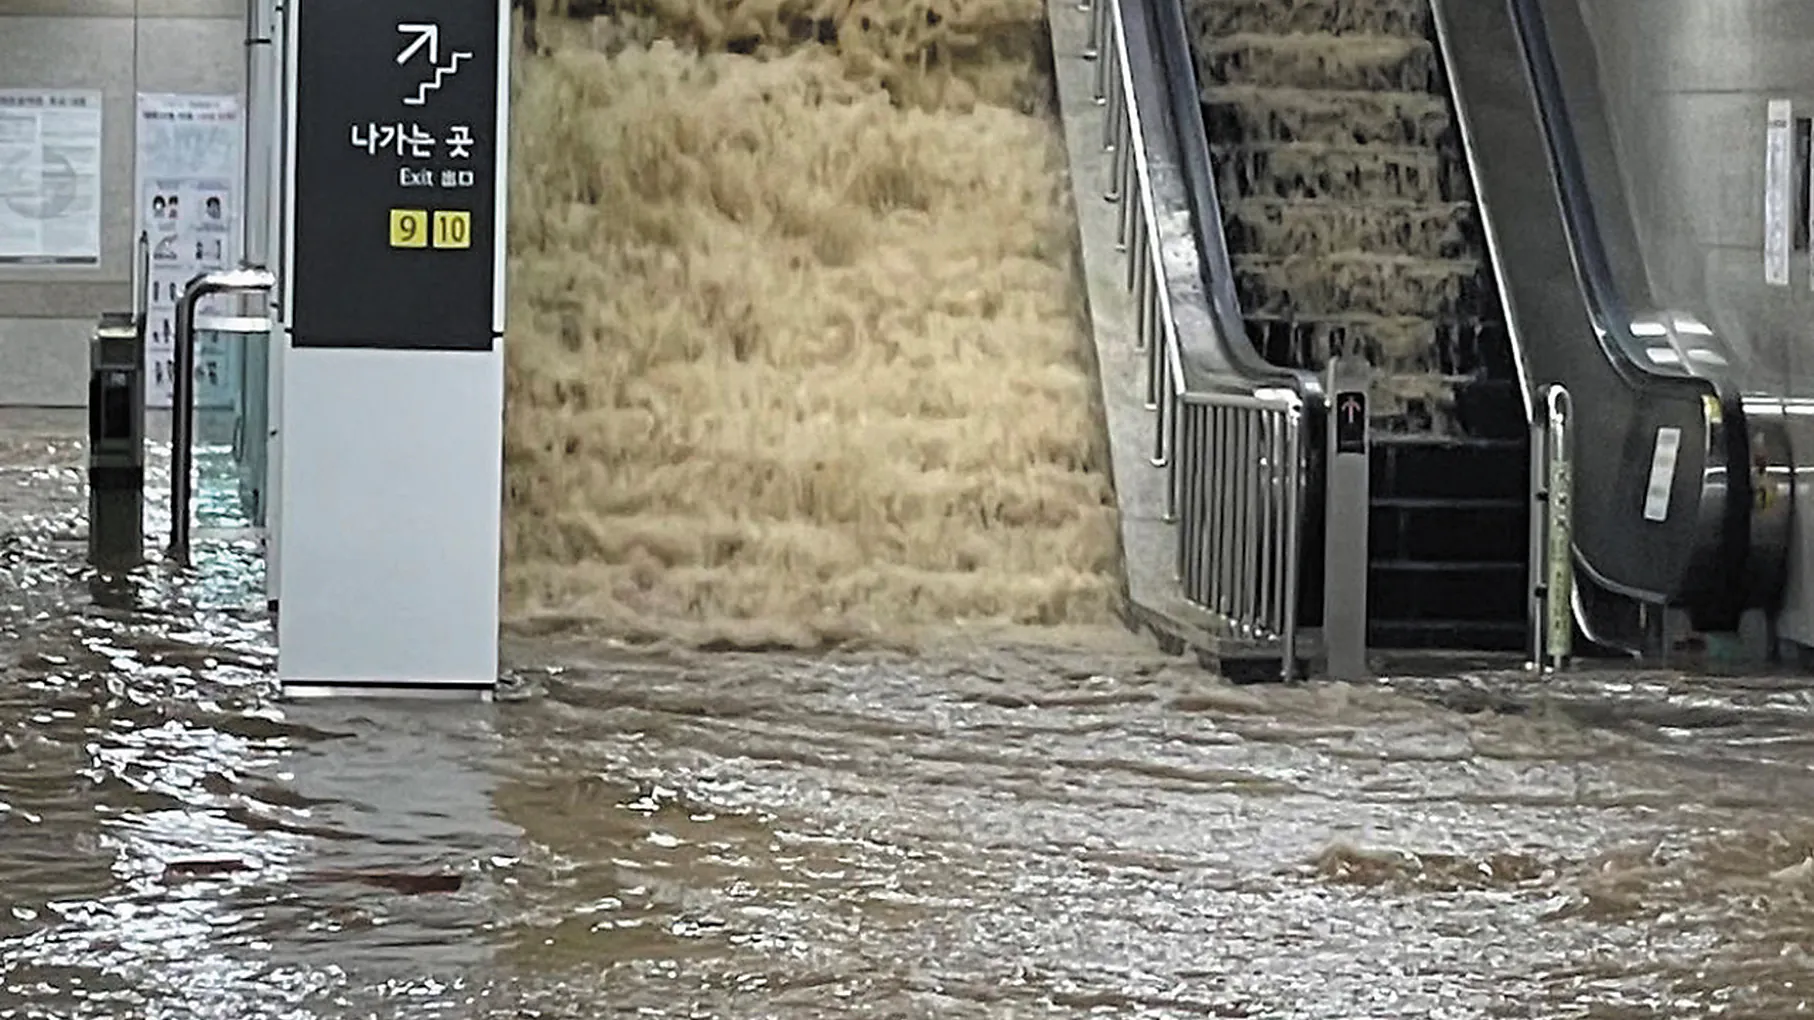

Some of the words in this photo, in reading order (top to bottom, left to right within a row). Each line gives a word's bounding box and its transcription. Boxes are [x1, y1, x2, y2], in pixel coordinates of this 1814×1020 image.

[351, 122, 436, 158] 나가는
[445, 125, 474, 158] 곳
[399, 167, 434, 187] Exit
[399, 215, 417, 242] 9
[439, 215, 466, 243] 10
